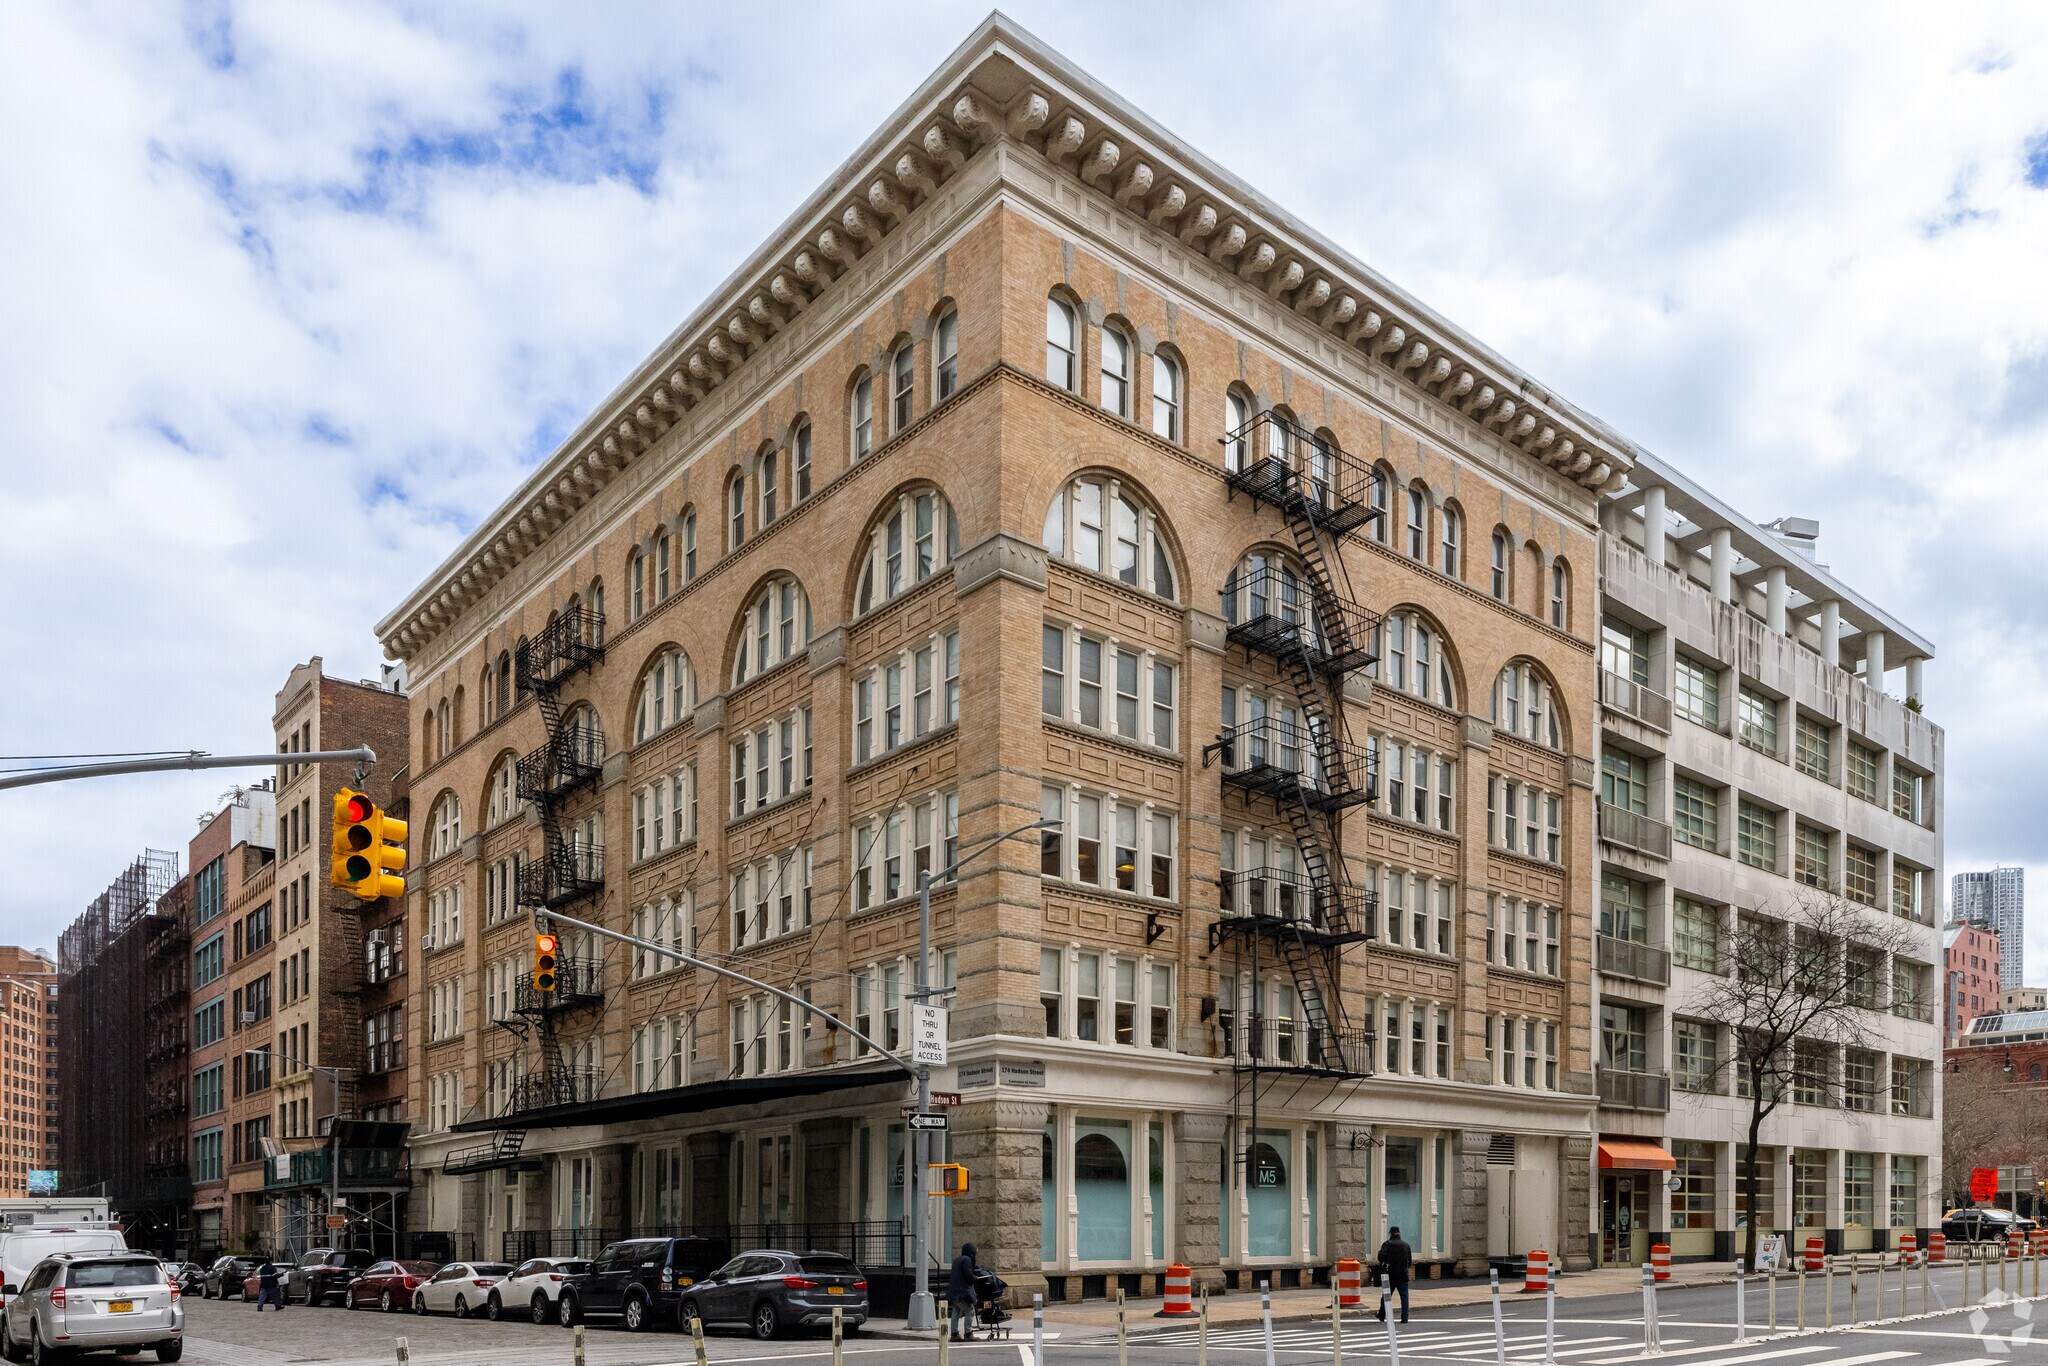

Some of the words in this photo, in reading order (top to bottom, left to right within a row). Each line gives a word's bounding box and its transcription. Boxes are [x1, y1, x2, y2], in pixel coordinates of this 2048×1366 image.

[925, 1009, 935, 1018] NO
[922, 1019, 938, 1029] THRU
[925, 1031, 935, 1039] OR
[918, 1040, 942, 1051] TUNNEL
[917, 1051, 943, 1061] ACCESS
[930, 1094, 950, 1105] Hudson
[951, 1095, 958, 1106] St
[914, 1117, 926, 1125] ONE
[930, 1118, 943, 1126] WAY
[1259, 1169, 1276, 1184] M5
